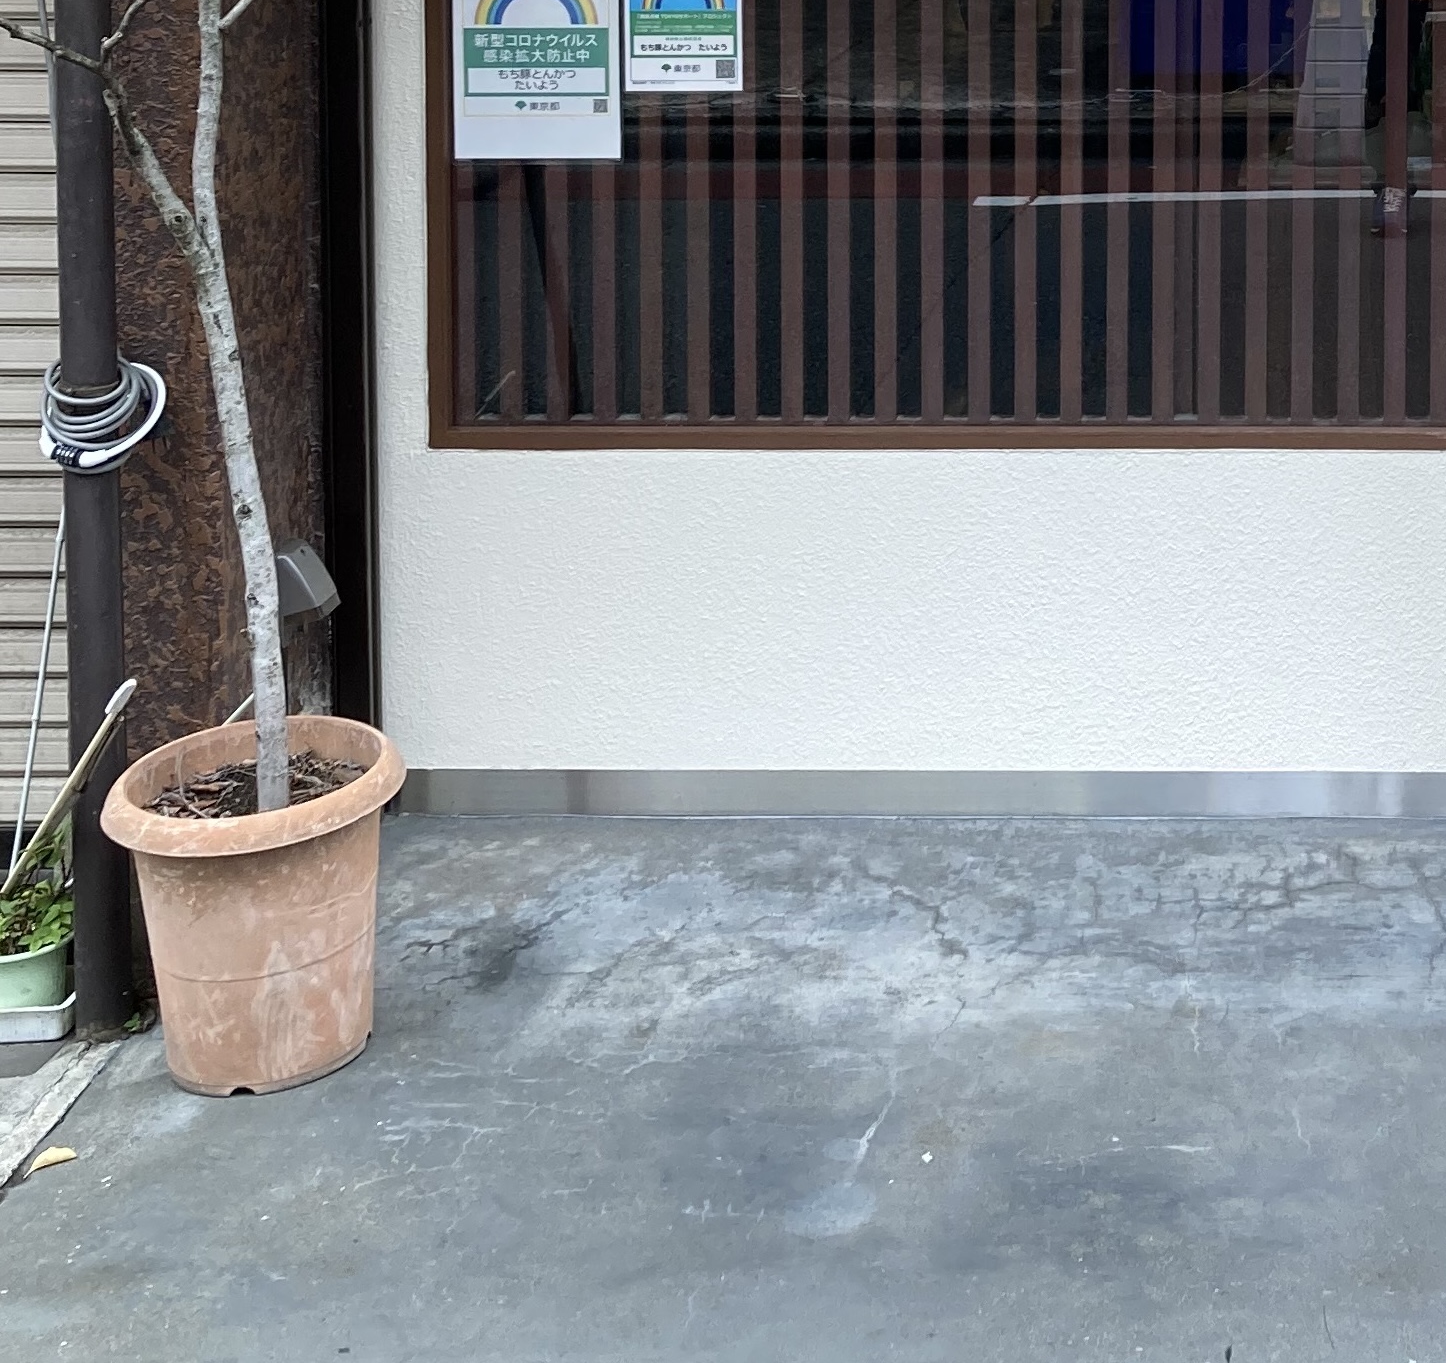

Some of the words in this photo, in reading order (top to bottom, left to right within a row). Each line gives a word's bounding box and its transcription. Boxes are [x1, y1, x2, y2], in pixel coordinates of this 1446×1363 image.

[474, 33, 598, 48] 新型コロナウイルス
[698, 43, 728, 52] たいよう
[483, 49, 590, 63] 感染拡大防止中
[498, 68, 577, 81] もち豚とんかつ
[514, 80, 559, 91] たいよう
[529, 101, 560, 112] 東京都
